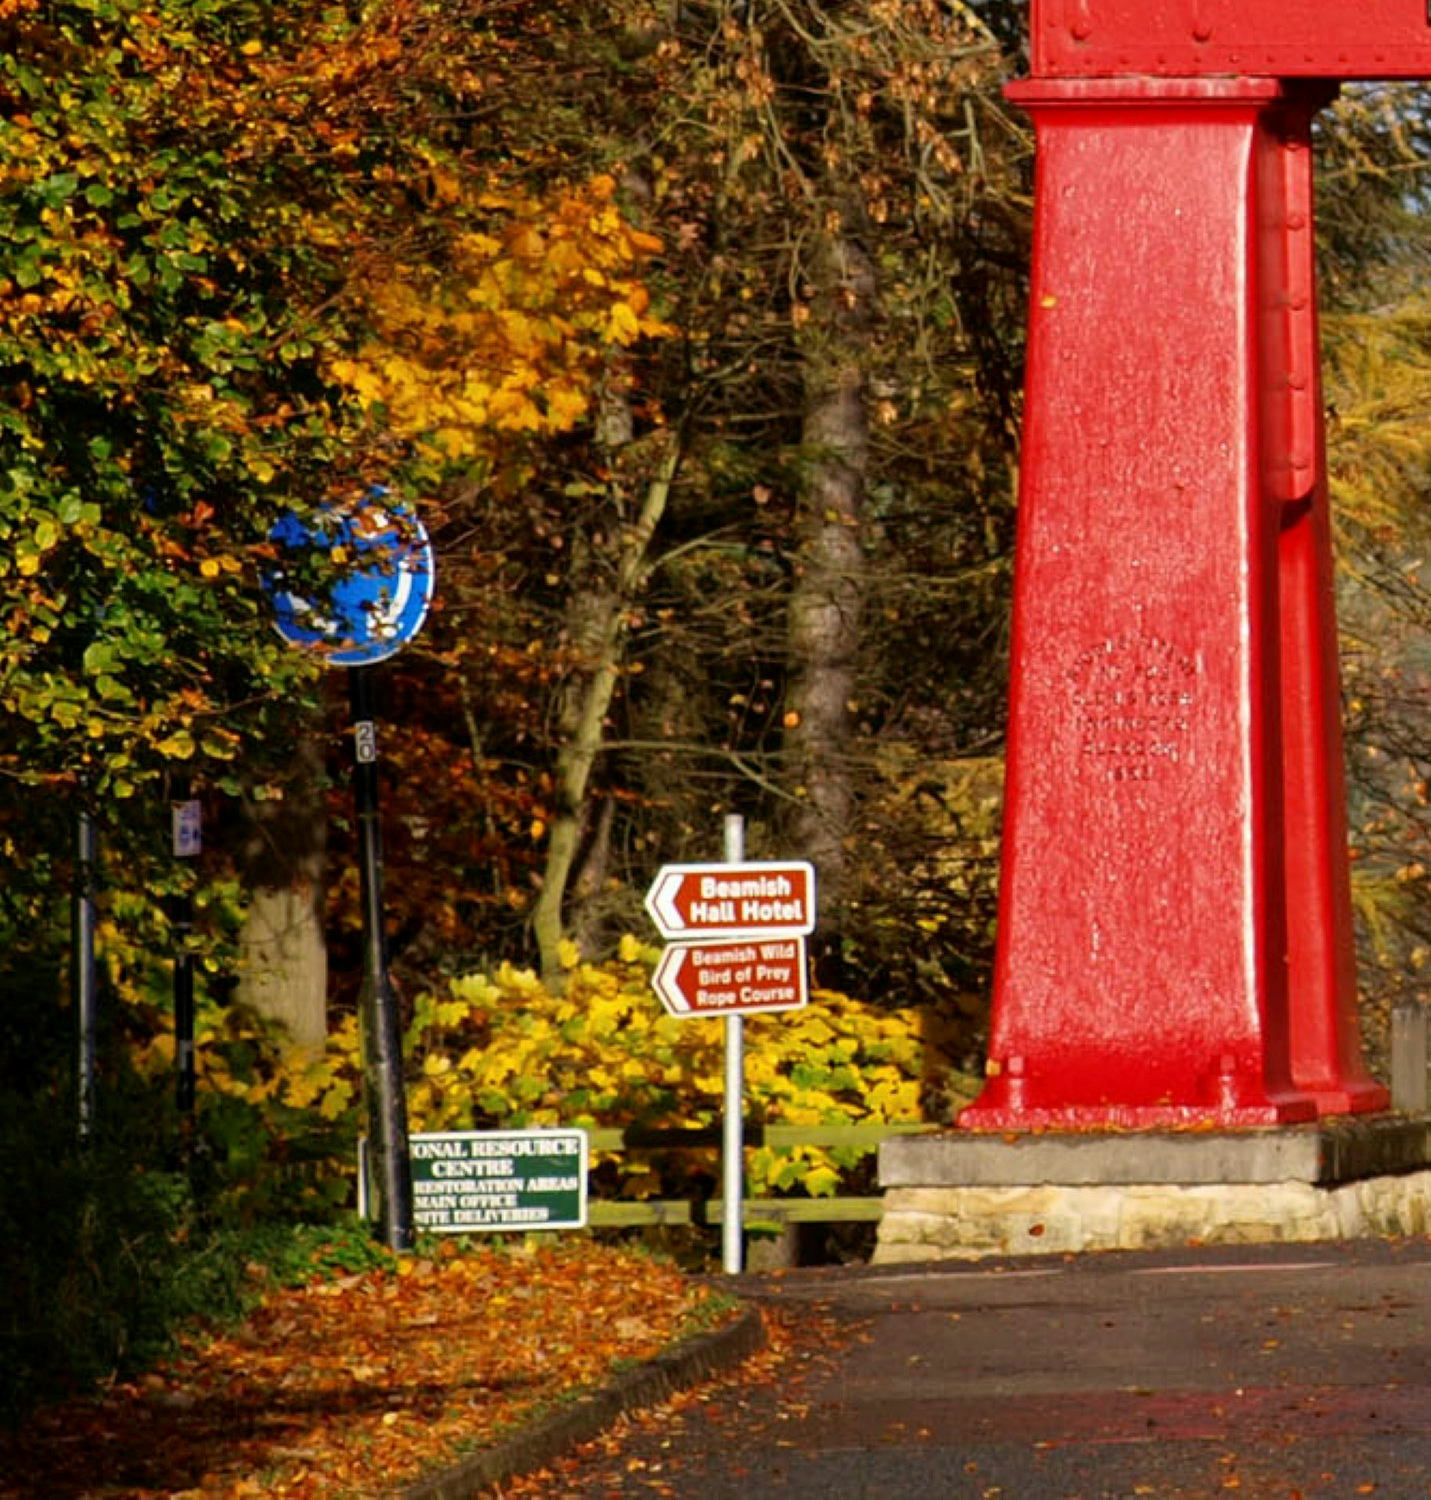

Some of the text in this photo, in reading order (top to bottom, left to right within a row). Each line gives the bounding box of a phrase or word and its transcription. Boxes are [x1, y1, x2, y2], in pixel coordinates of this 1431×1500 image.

[701, 876, 792, 899] Beamish
[690, 899, 803, 923] Hall Hotel
[692, 943, 795, 966] Beamish Wild
[698, 965, 790, 986] Bird of Prey
[696, 986, 795, 1007] Rope Course
[471, 1138, 579, 1157] RESOURCE
[431, 1159, 514, 1178] CENTRE
[413, 1176, 578, 1196] RESTORATION AREAS
[413, 1192, 518, 1210] MAIN OFFICE
[454, 1207, 549, 1224] DELIVERIES
